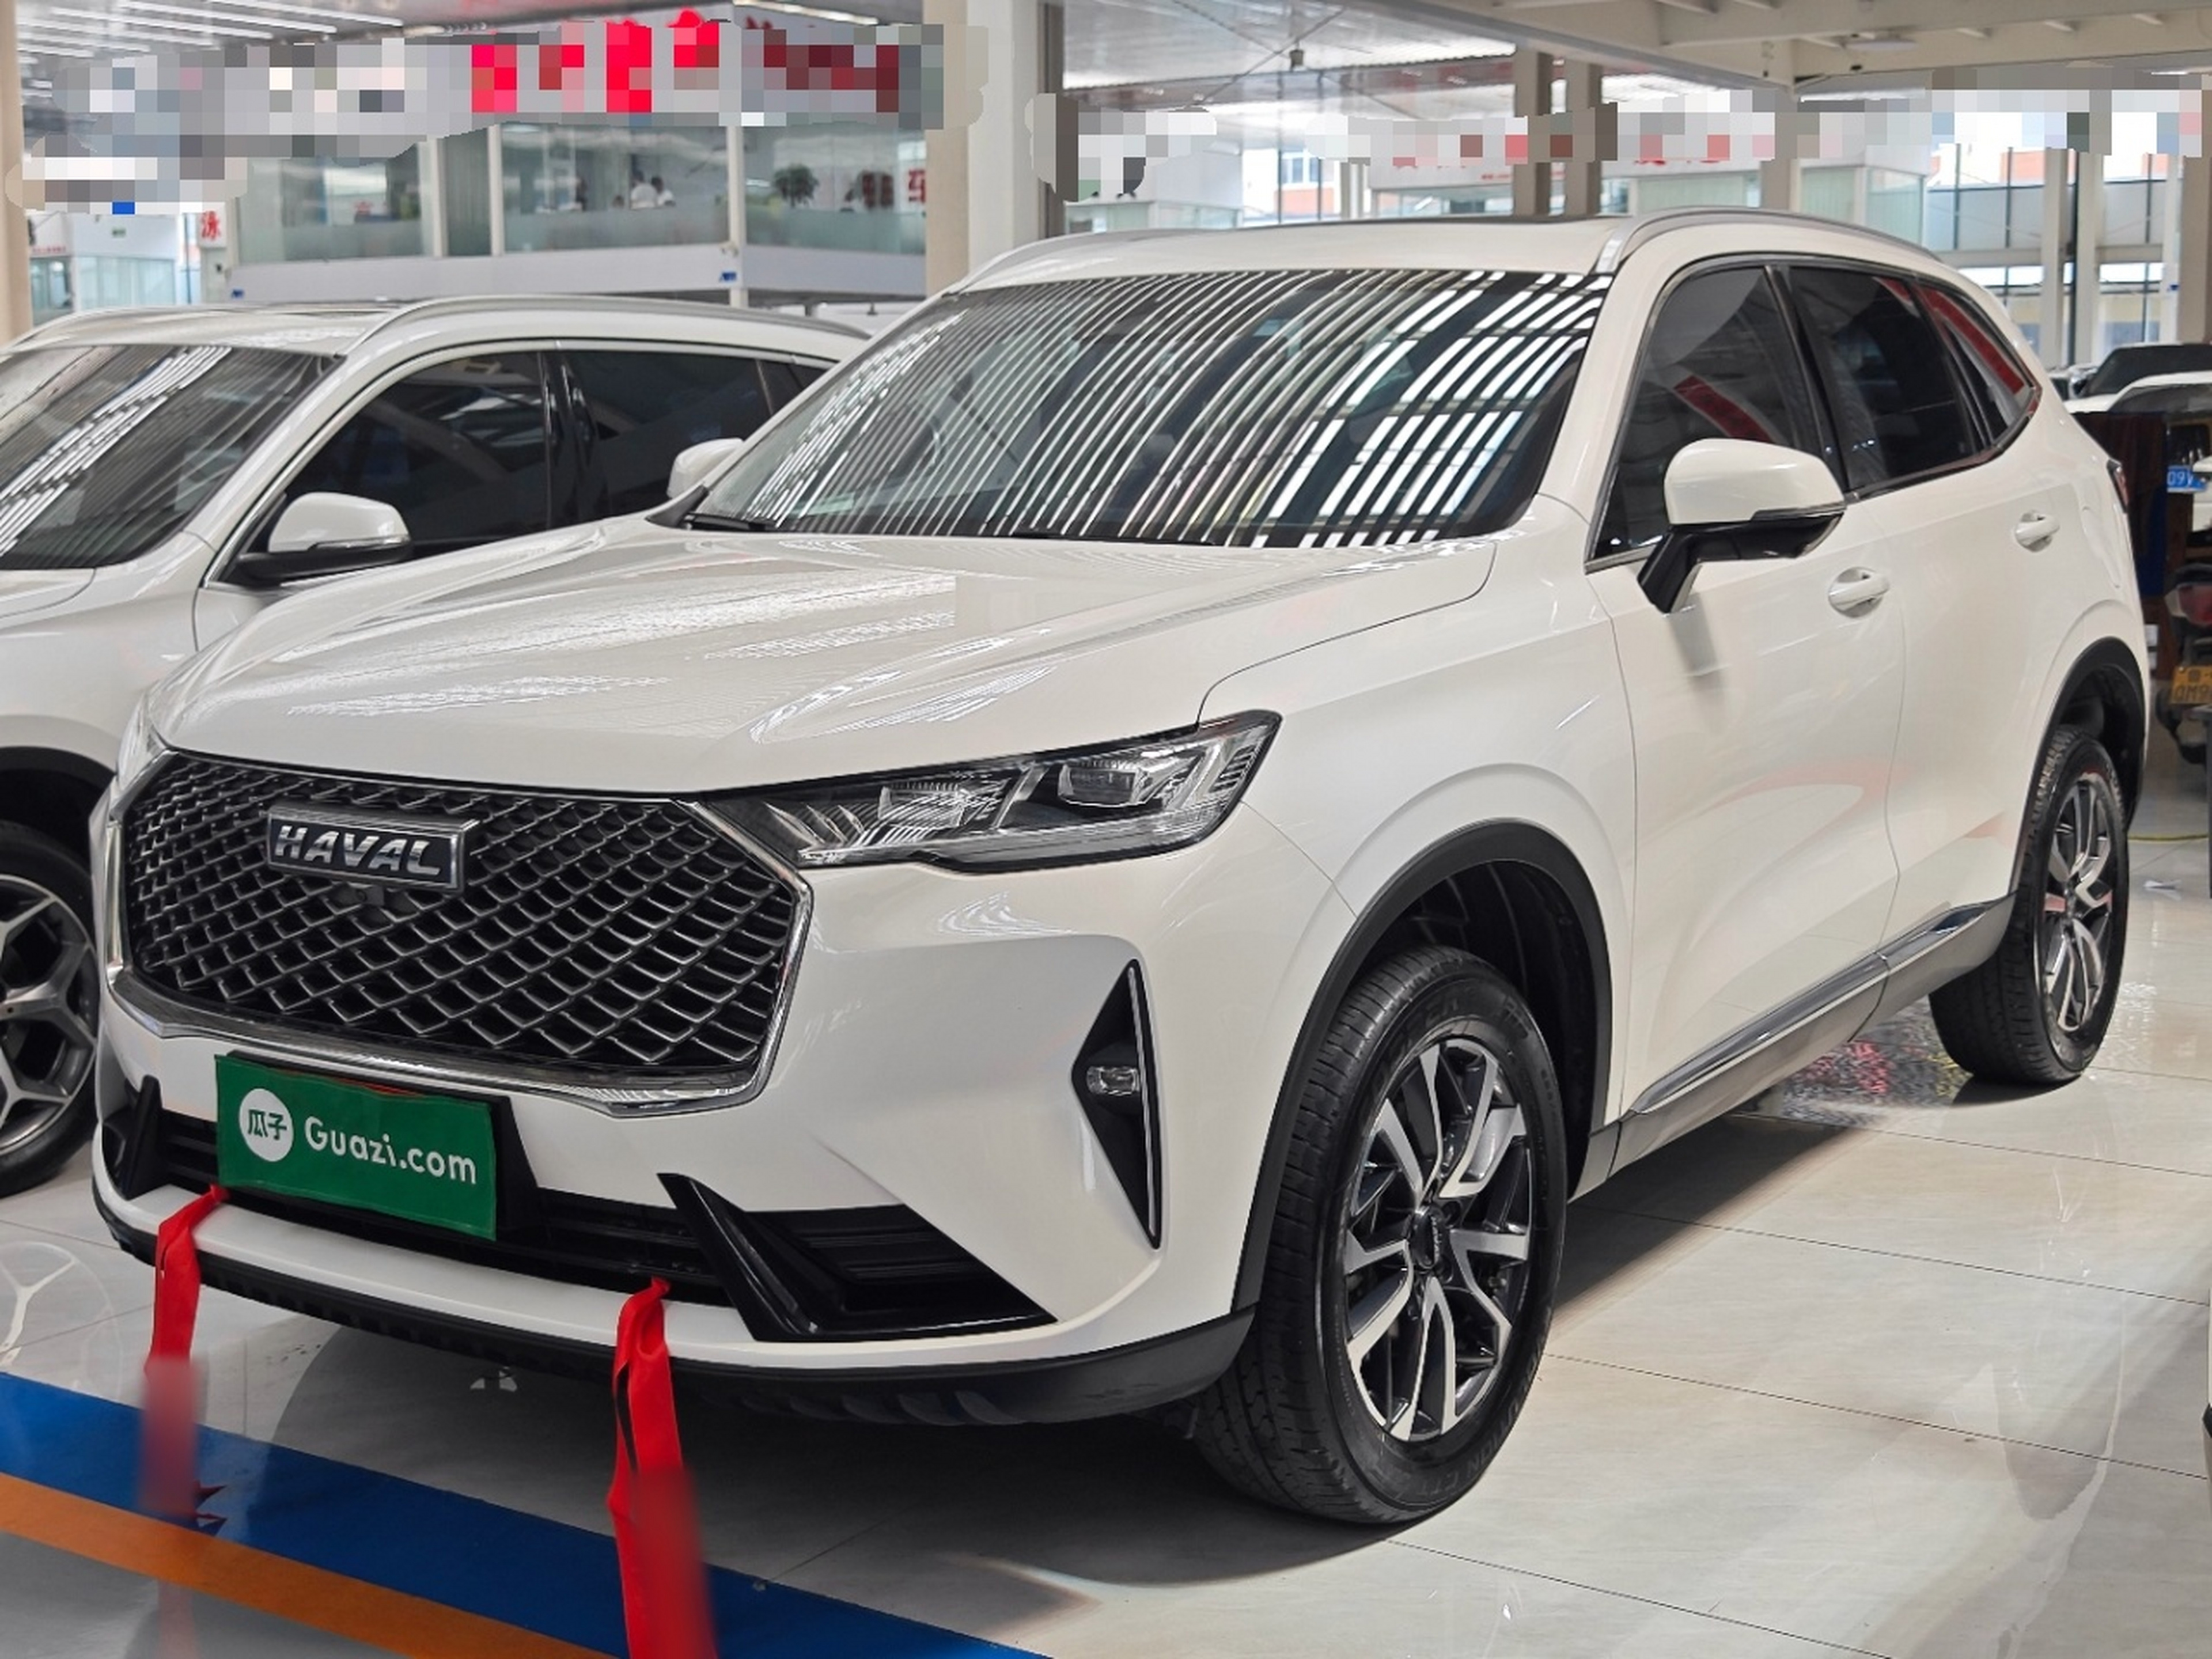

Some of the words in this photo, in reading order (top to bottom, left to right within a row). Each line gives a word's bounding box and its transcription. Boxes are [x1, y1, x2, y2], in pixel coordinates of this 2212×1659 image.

[275, 825, 440, 875] HAVAL
[248, 1109, 287, 1140] 瓜子
[305, 1116, 476, 1184] Guazi.com
